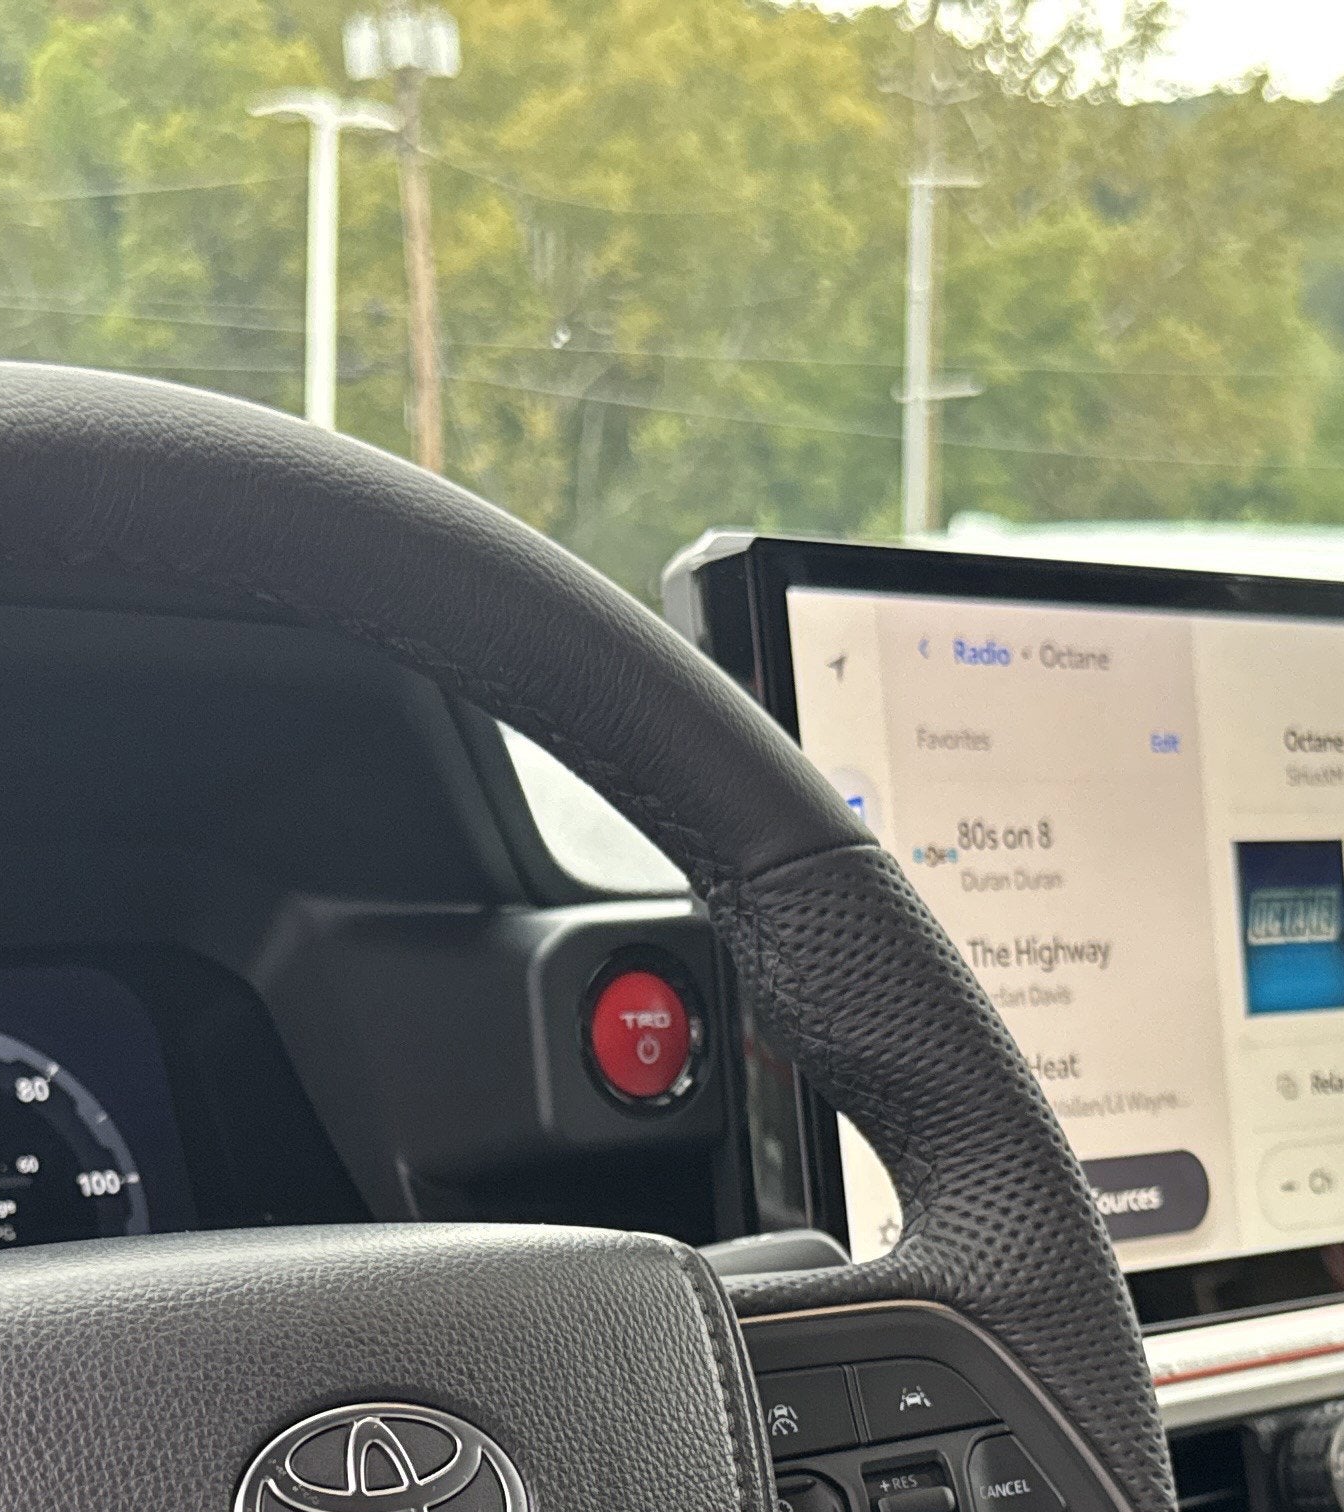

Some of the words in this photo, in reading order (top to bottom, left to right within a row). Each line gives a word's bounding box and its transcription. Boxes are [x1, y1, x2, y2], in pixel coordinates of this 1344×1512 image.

[954, 637, 1011, 667] Radio
[1038, 643, 1110, 671] Octane
[916, 727, 991, 752] Favorites
[956, 817, 998, 850] 80s
[1003, 827, 1032, 850] on
[1037, 818, 1053, 849] 8
[967, 939, 1009, 968] The
[1015, 935, 1112, 972] Highway
[620, 1010, 672, 1031] TRD
[15, 1075, 50, 1103] 80
[77, 1168, 121, 1197] 100
[979, 1479, 1031, 1499] CANCEL
